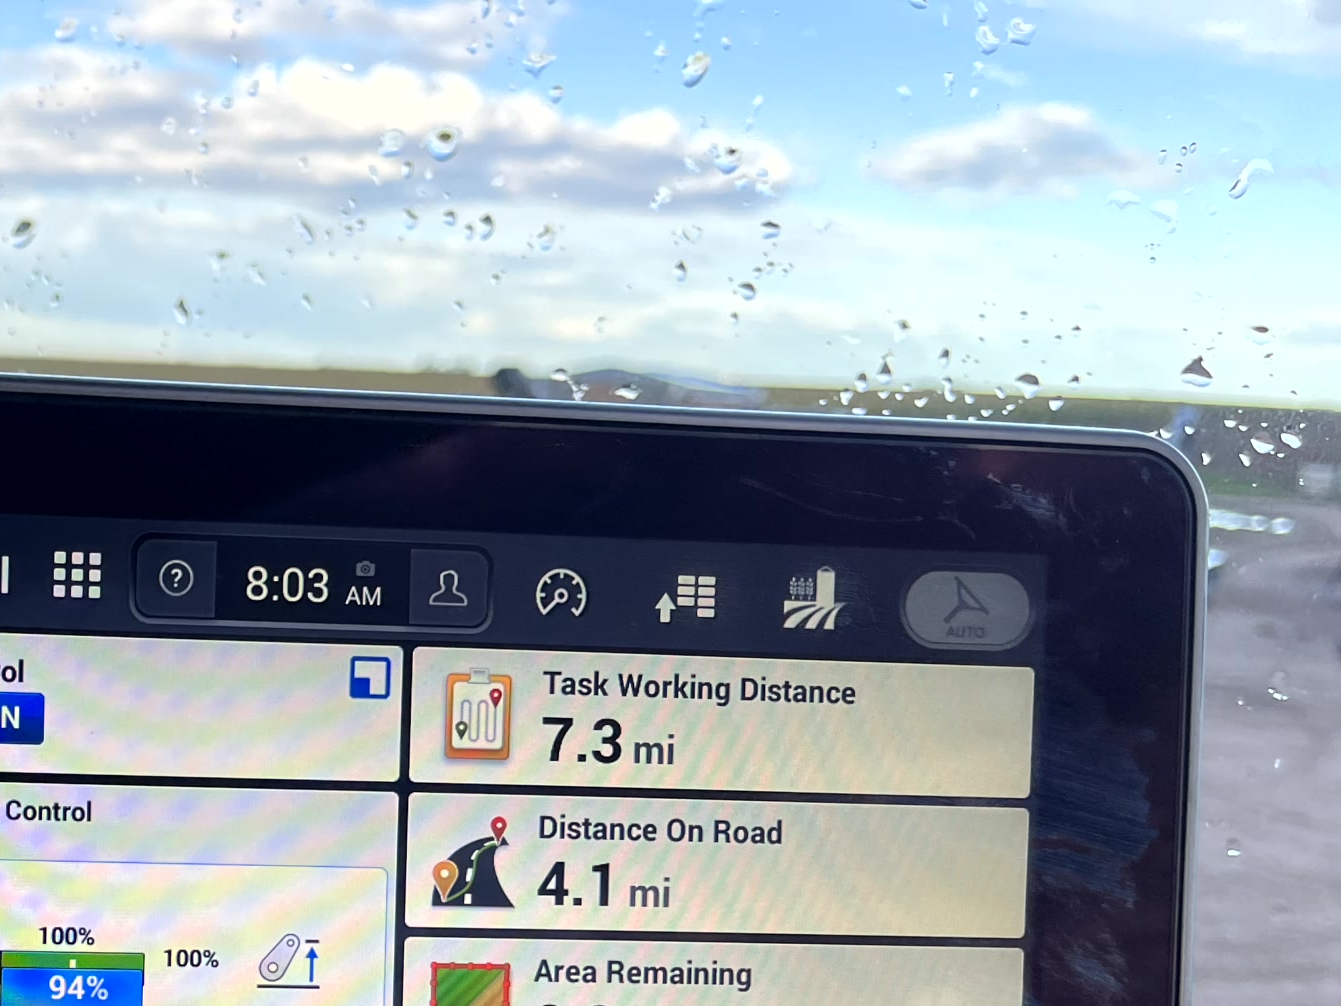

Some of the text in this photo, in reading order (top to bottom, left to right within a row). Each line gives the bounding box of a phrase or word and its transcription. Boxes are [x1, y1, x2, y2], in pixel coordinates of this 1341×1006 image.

[246, 565, 329, 603] 8:03
[345, 586, 382, 606] AM
[946, 626, 985, 638] AUTO
[543, 670, 856, 706] Task Working Distance
[541, 717, 675, 765] 7.3 mi
[5, 800, 92, 822] Control
[539, 815, 783, 845] Distance On Road
[537, 861, 670, 908] 4.1 mi
[38, 927, 95, 946] 100%
[164, 949, 220, 968] 100%
[49, 975, 109, 1000] 94%
[534, 960, 752, 990] Area Remaining
